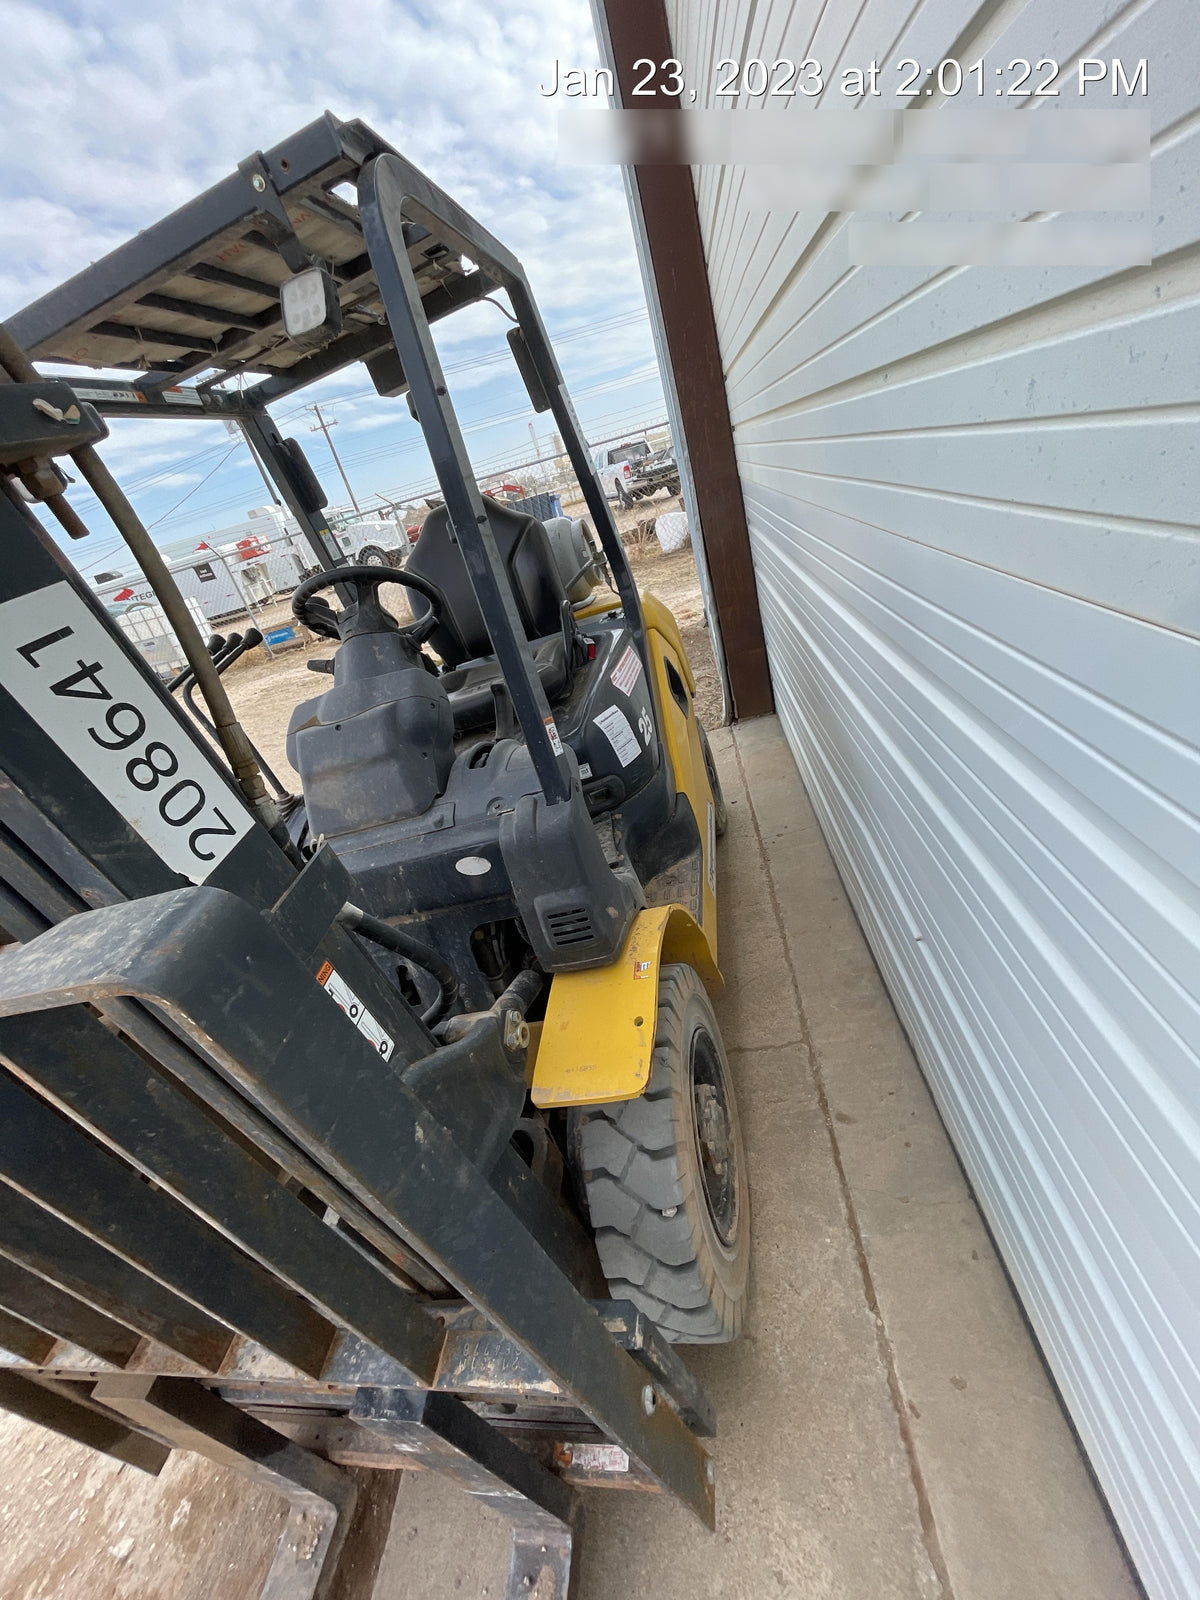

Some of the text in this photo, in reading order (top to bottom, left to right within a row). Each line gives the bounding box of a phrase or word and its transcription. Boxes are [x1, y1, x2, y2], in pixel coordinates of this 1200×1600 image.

[16, 625, 237, 862] 208641
[638, 706, 652, 746] 25
[318, 963, 331, 984] NING
